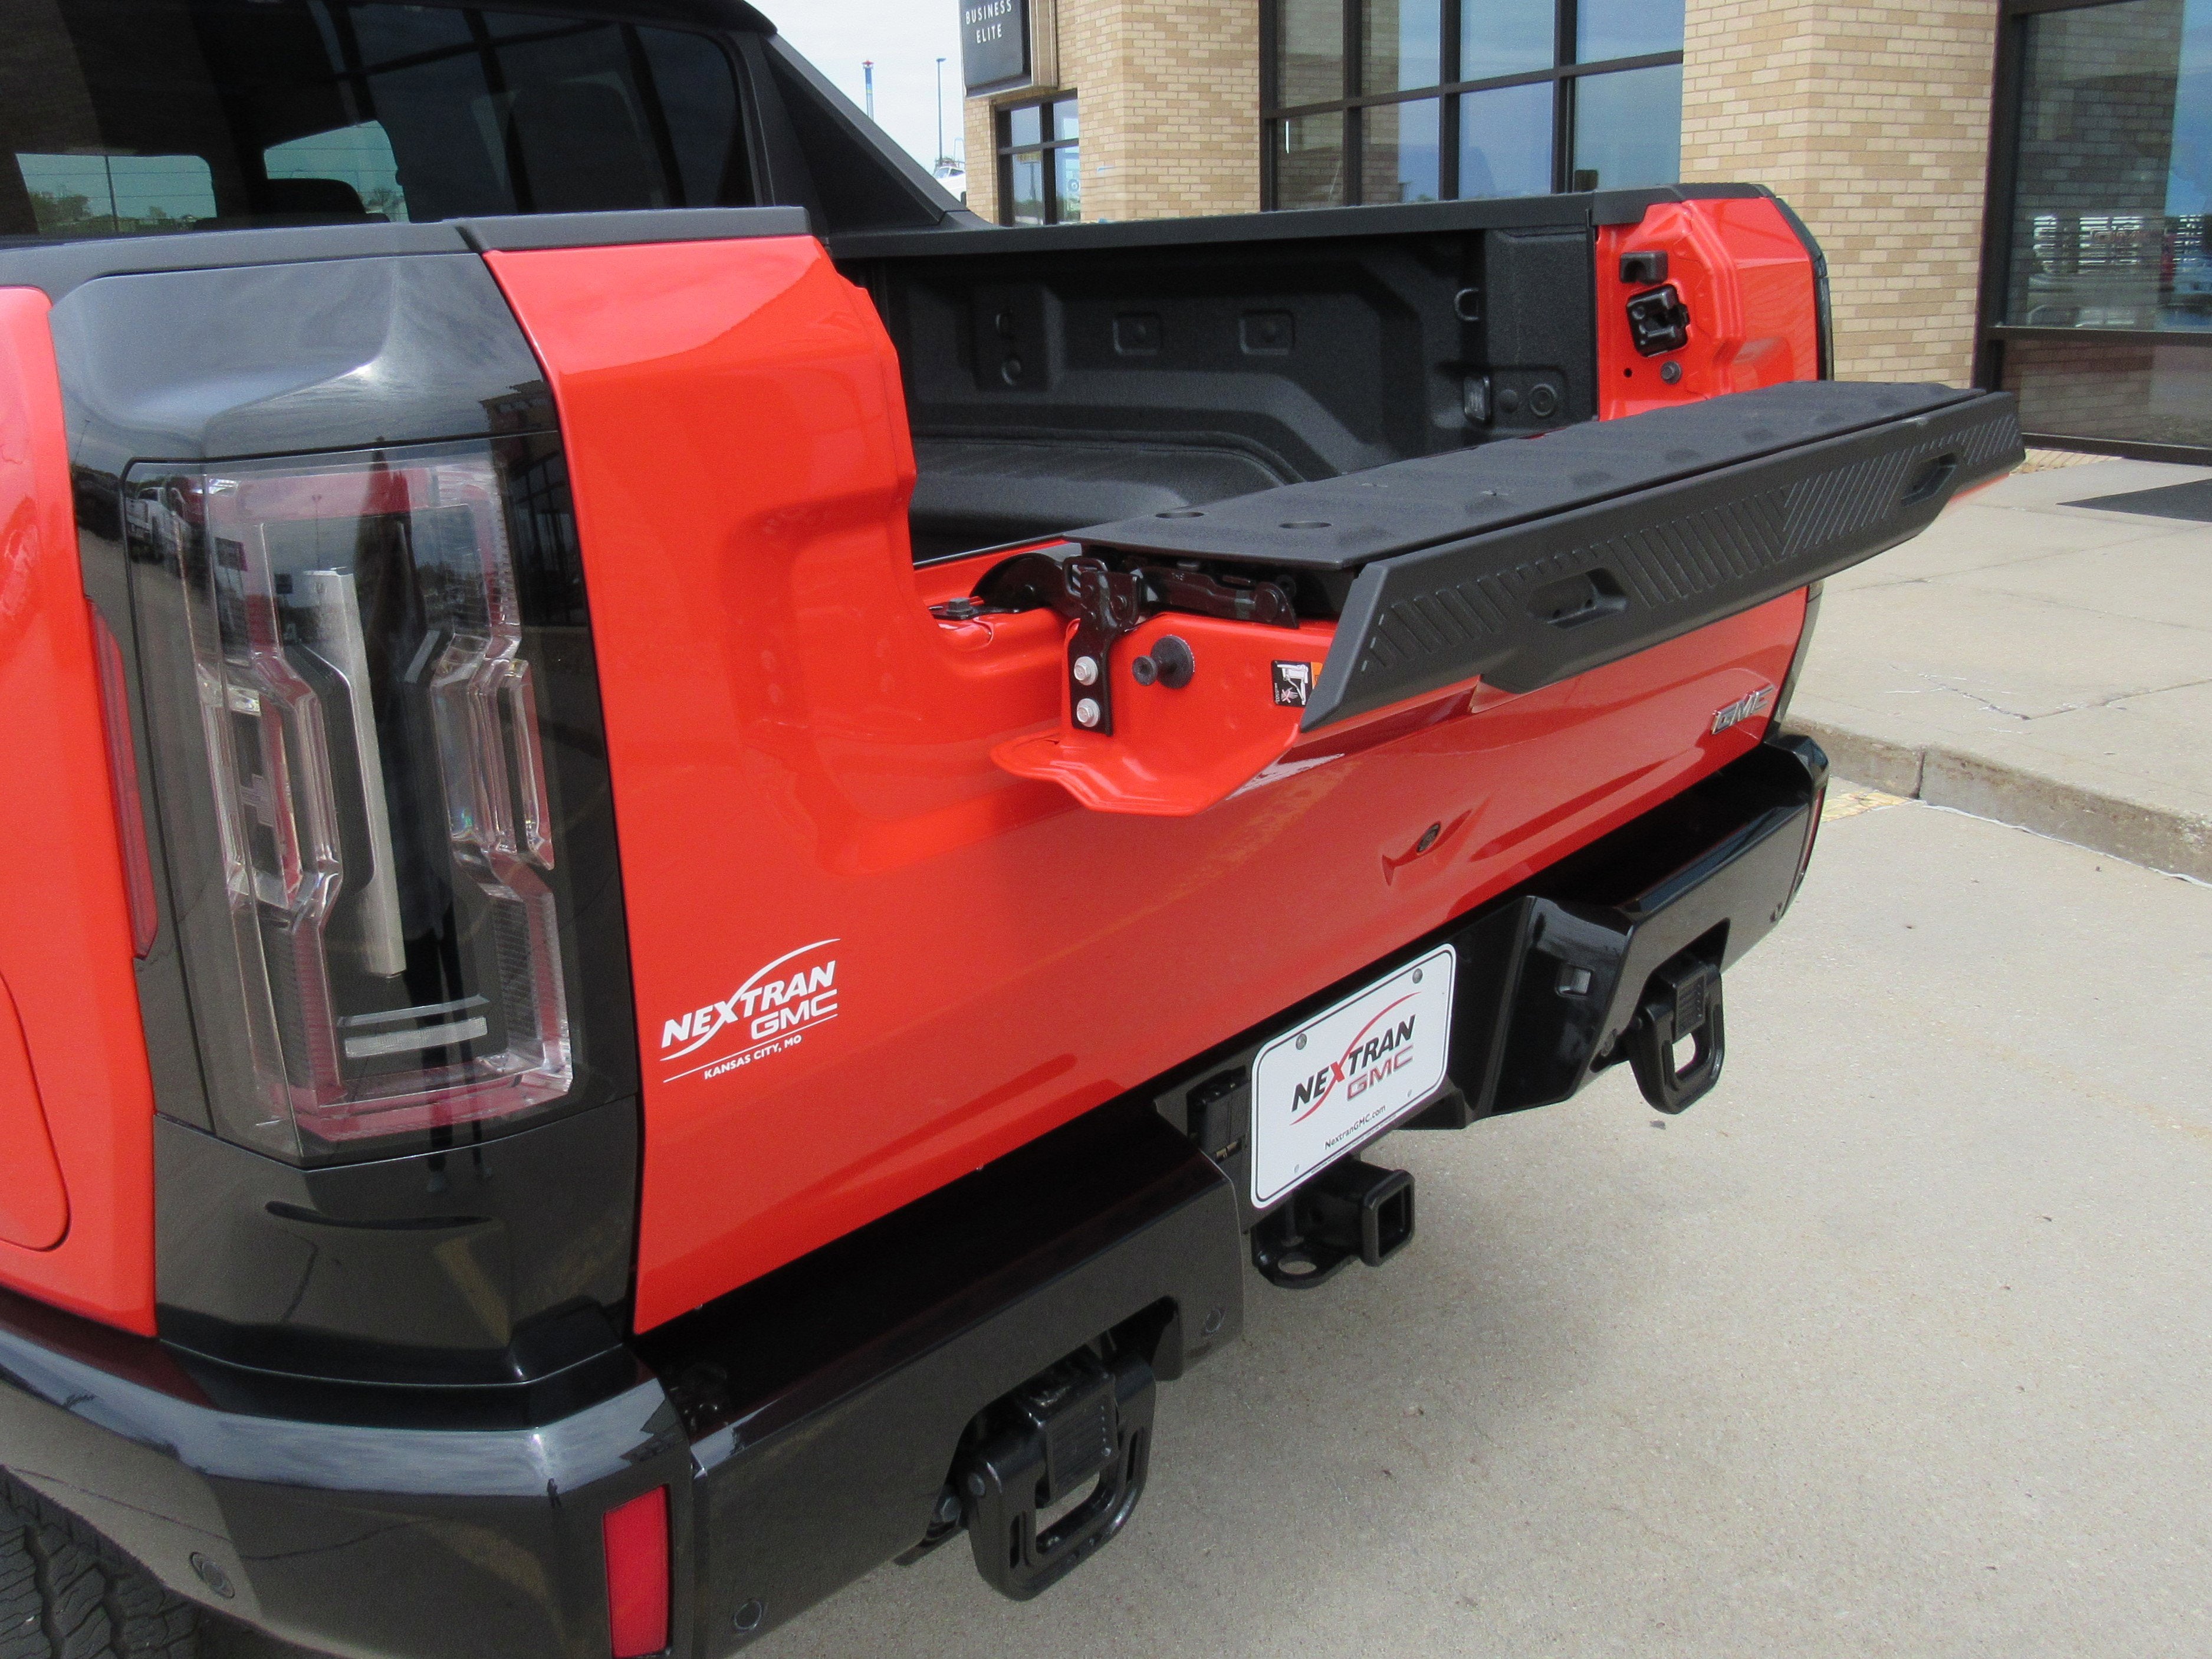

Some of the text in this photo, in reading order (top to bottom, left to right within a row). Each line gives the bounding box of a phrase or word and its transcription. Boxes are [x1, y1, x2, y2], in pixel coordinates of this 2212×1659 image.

[965, 0, 1011, 25] BUSINESS
[976, 24, 1002, 44] ELITE
[660, 960, 836, 1049] NEXTRAN
[750, 988, 838, 1040] GMC
[704, 1034, 802, 1080] KANSAS CITY, MO
[1291, 1014, 1416, 1112] NEXTRAN
[1346, 1044, 1414, 1102] GMC
[1324, 1105, 1386, 1151] NextranGMC.com
